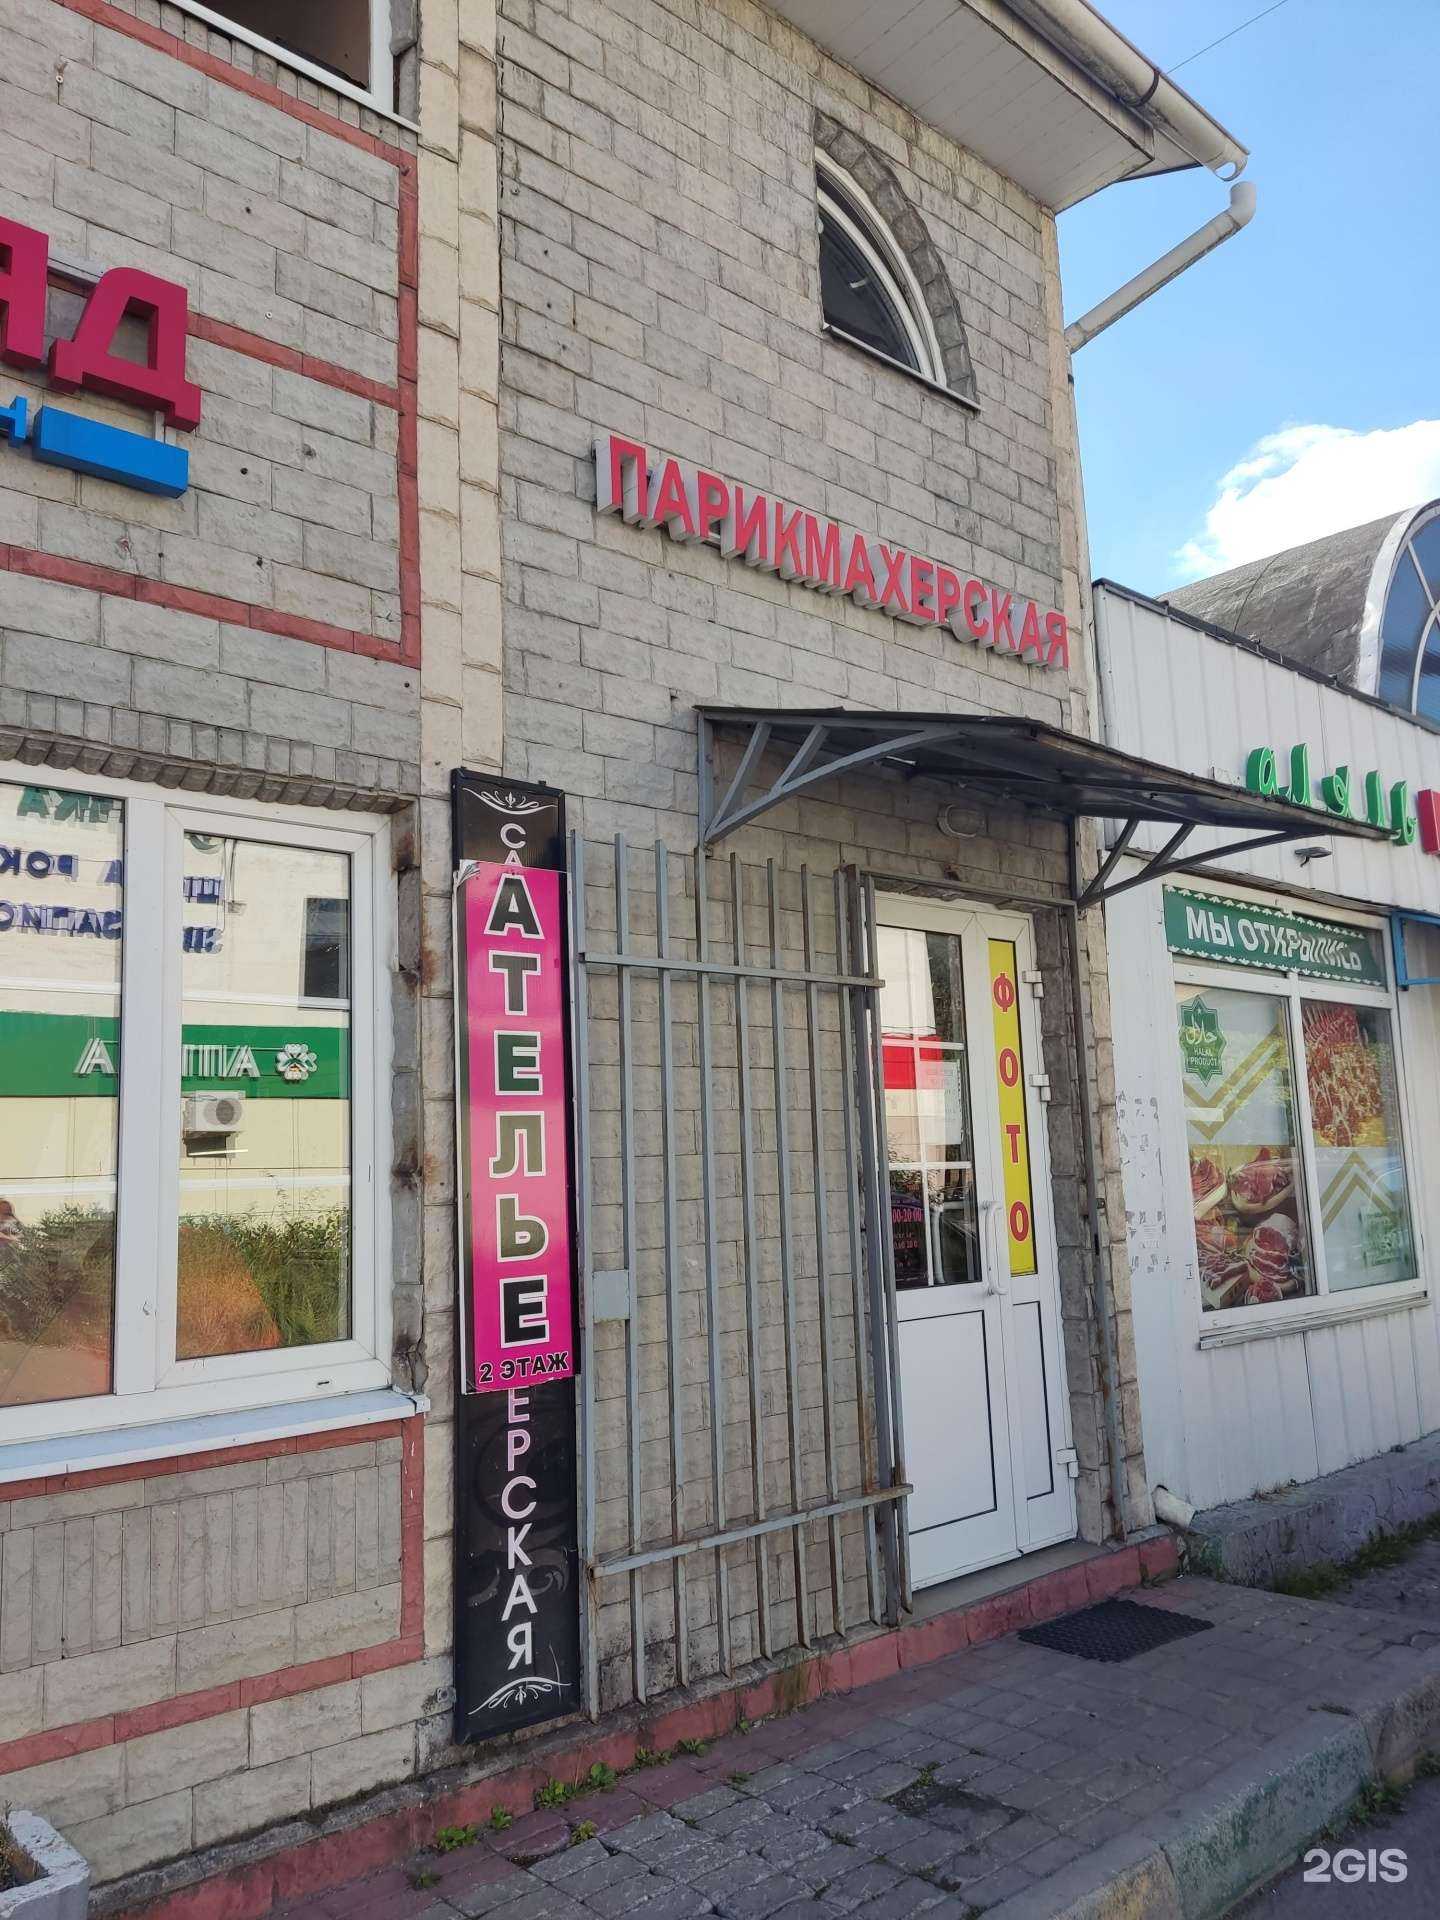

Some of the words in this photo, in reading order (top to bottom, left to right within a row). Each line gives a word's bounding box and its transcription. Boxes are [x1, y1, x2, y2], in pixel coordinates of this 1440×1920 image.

[598, 435, 1069, 670] ПАРИКМАХЕРСКАЯ
[1185, 905, 1234, 948] МЫ
[1237, 917, 1363, 971] ОТКРЫЛИСЬ
[484, 874, 550, 1348] АТЕЛЬЕ
[993, 972, 1030, 1242] ФОТО
[479, 1362, 494, 1384] 2
[500, 1351, 569, 1379] ЭТАЖ
